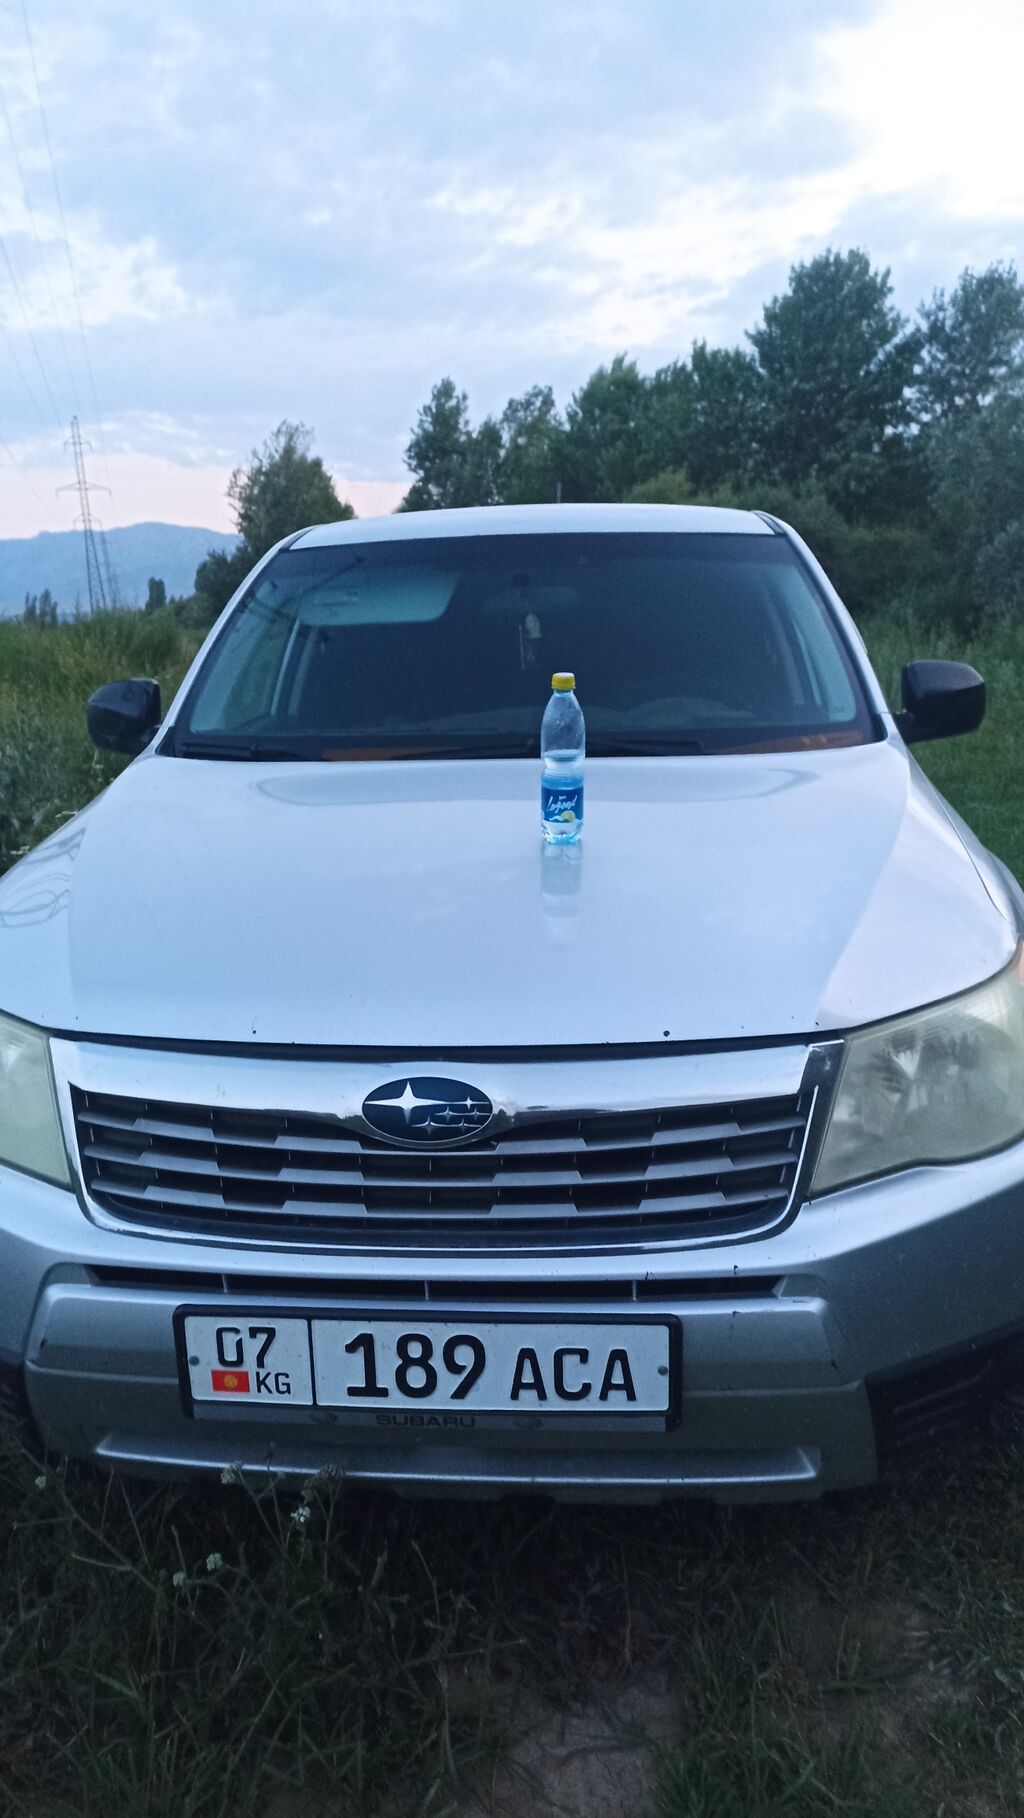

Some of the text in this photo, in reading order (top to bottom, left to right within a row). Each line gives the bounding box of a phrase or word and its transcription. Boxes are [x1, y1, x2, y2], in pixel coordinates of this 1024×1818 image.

[215, 1326, 276, 1369] 07
[256, 1371, 291, 1395] KG
[344, 1332, 637, 1402] 189 ACA
[375, 1413, 476, 1428] SUBARU
